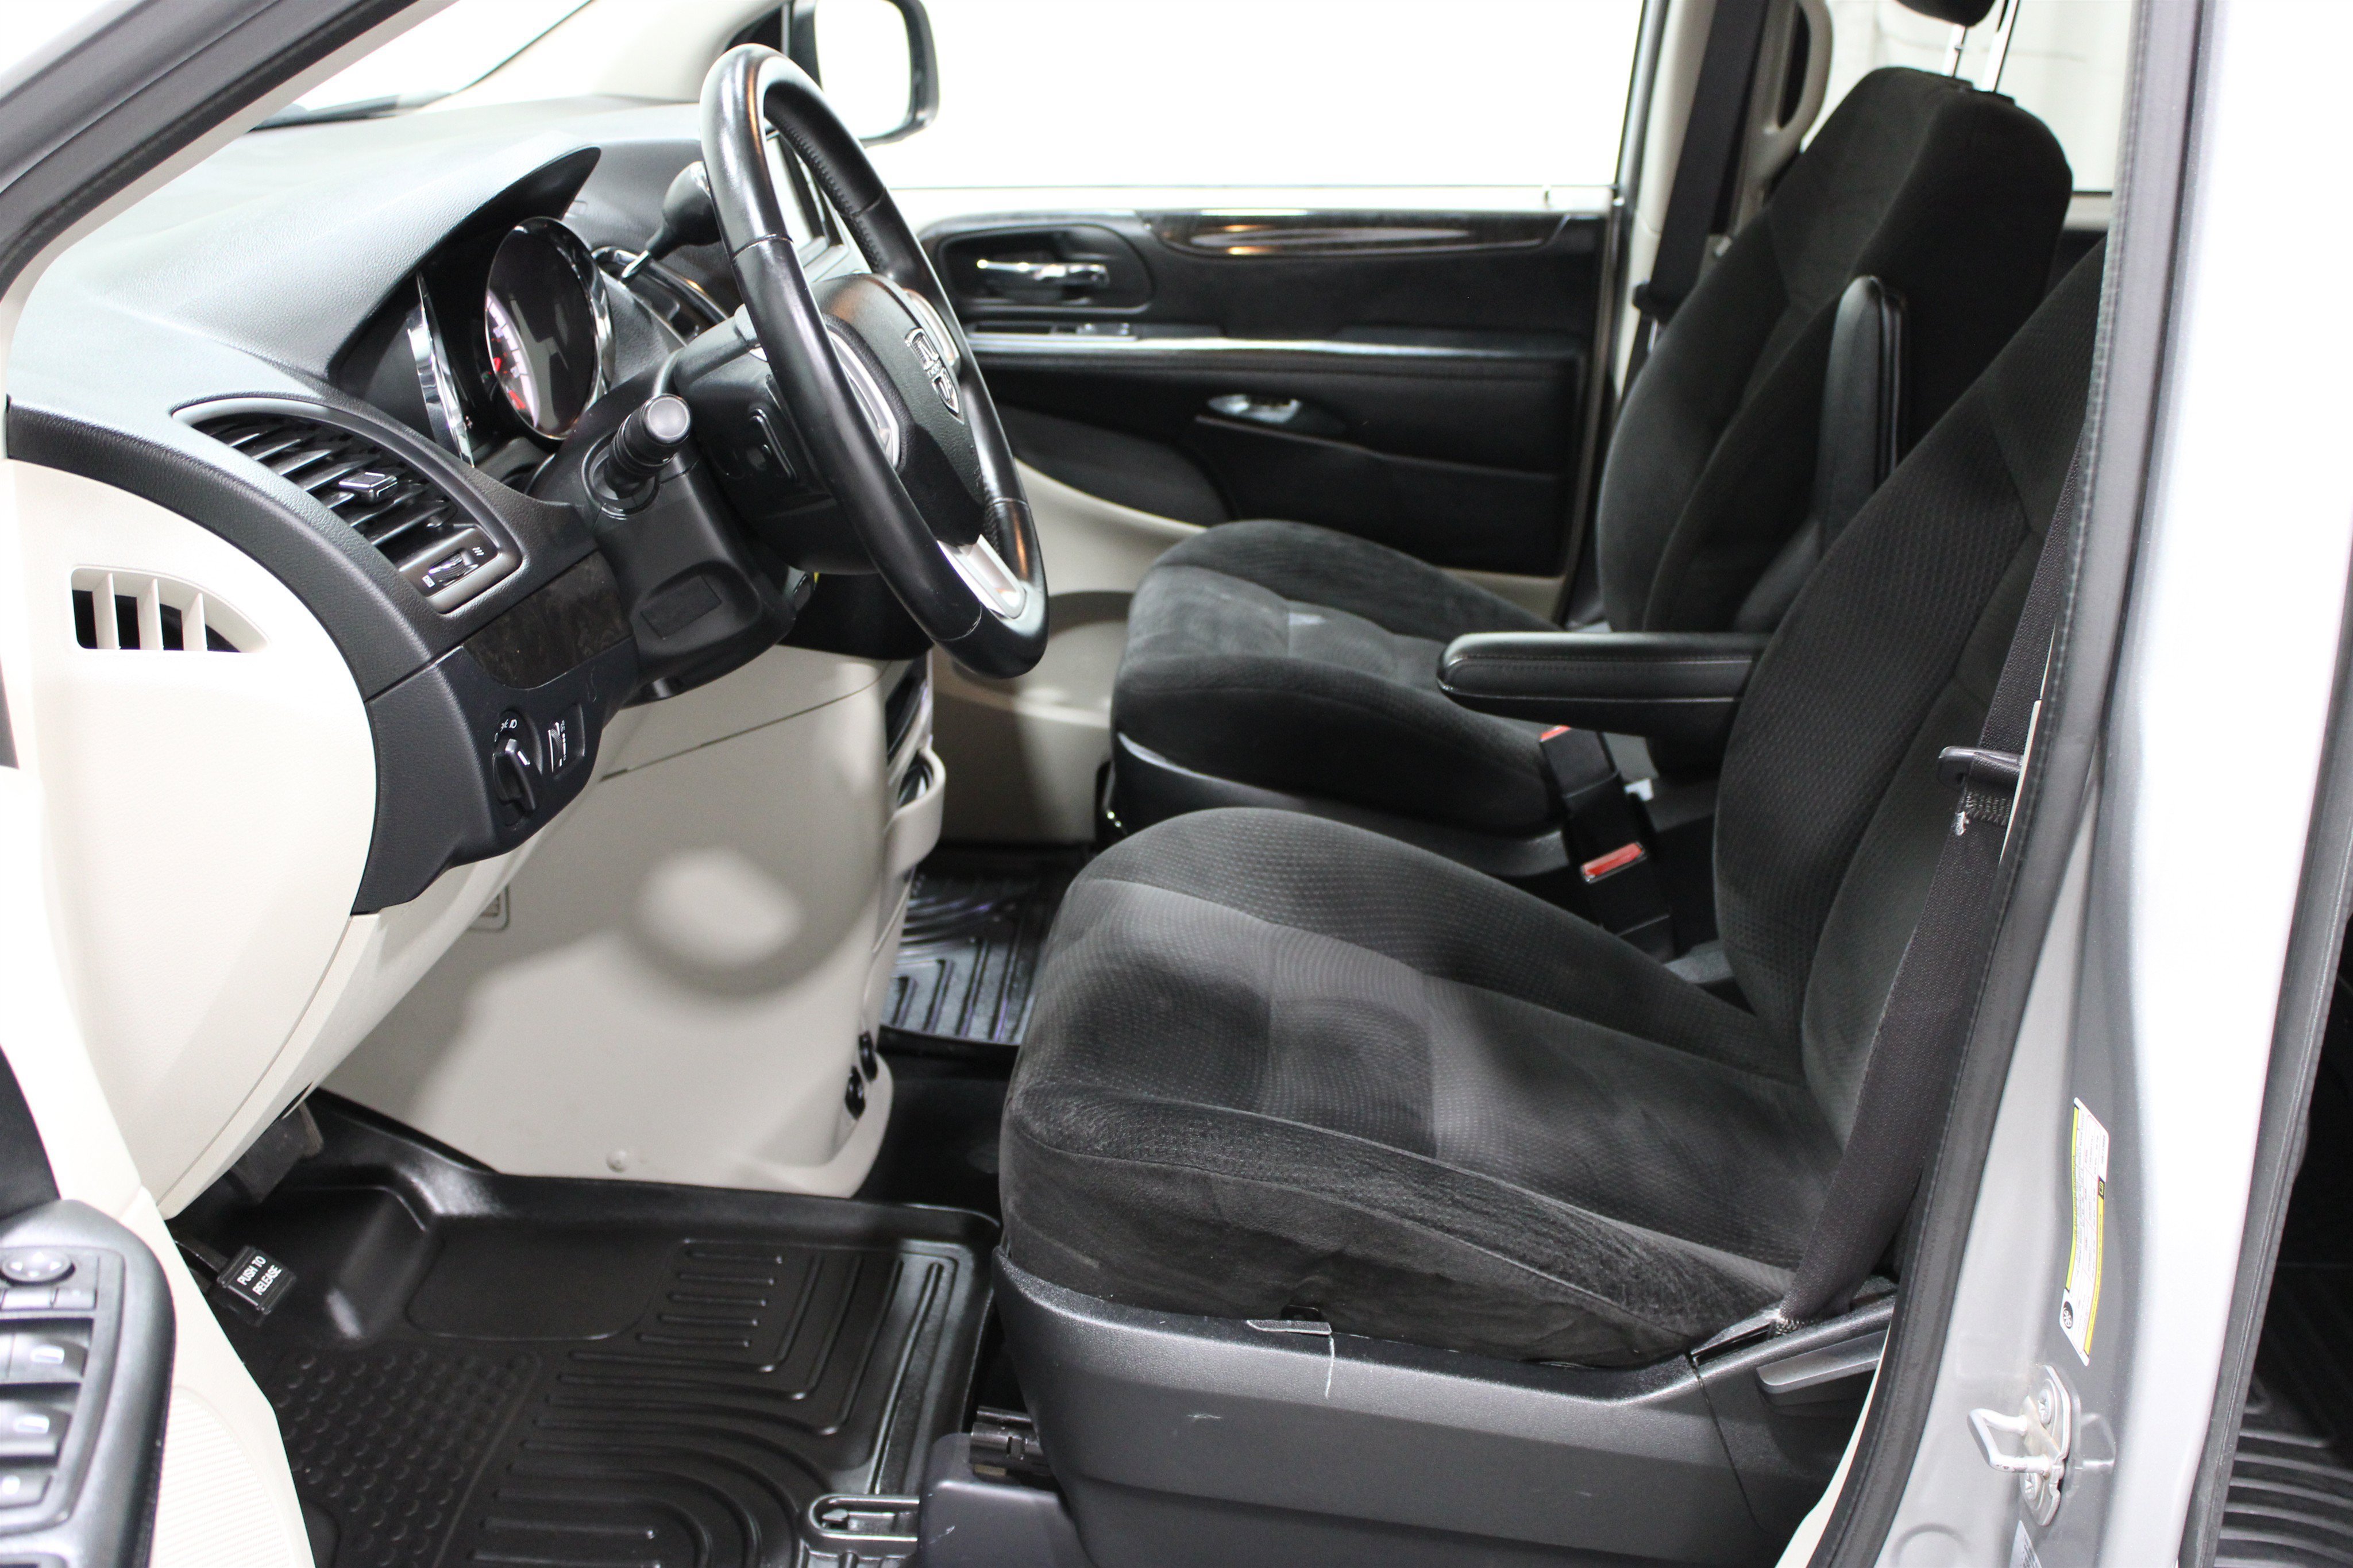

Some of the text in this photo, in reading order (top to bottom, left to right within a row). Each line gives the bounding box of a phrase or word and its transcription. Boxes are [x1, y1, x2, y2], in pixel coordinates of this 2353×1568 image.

[237, 1256, 267, 1285] PUSH TO
[252, 1265, 282, 1295] RELEASE
